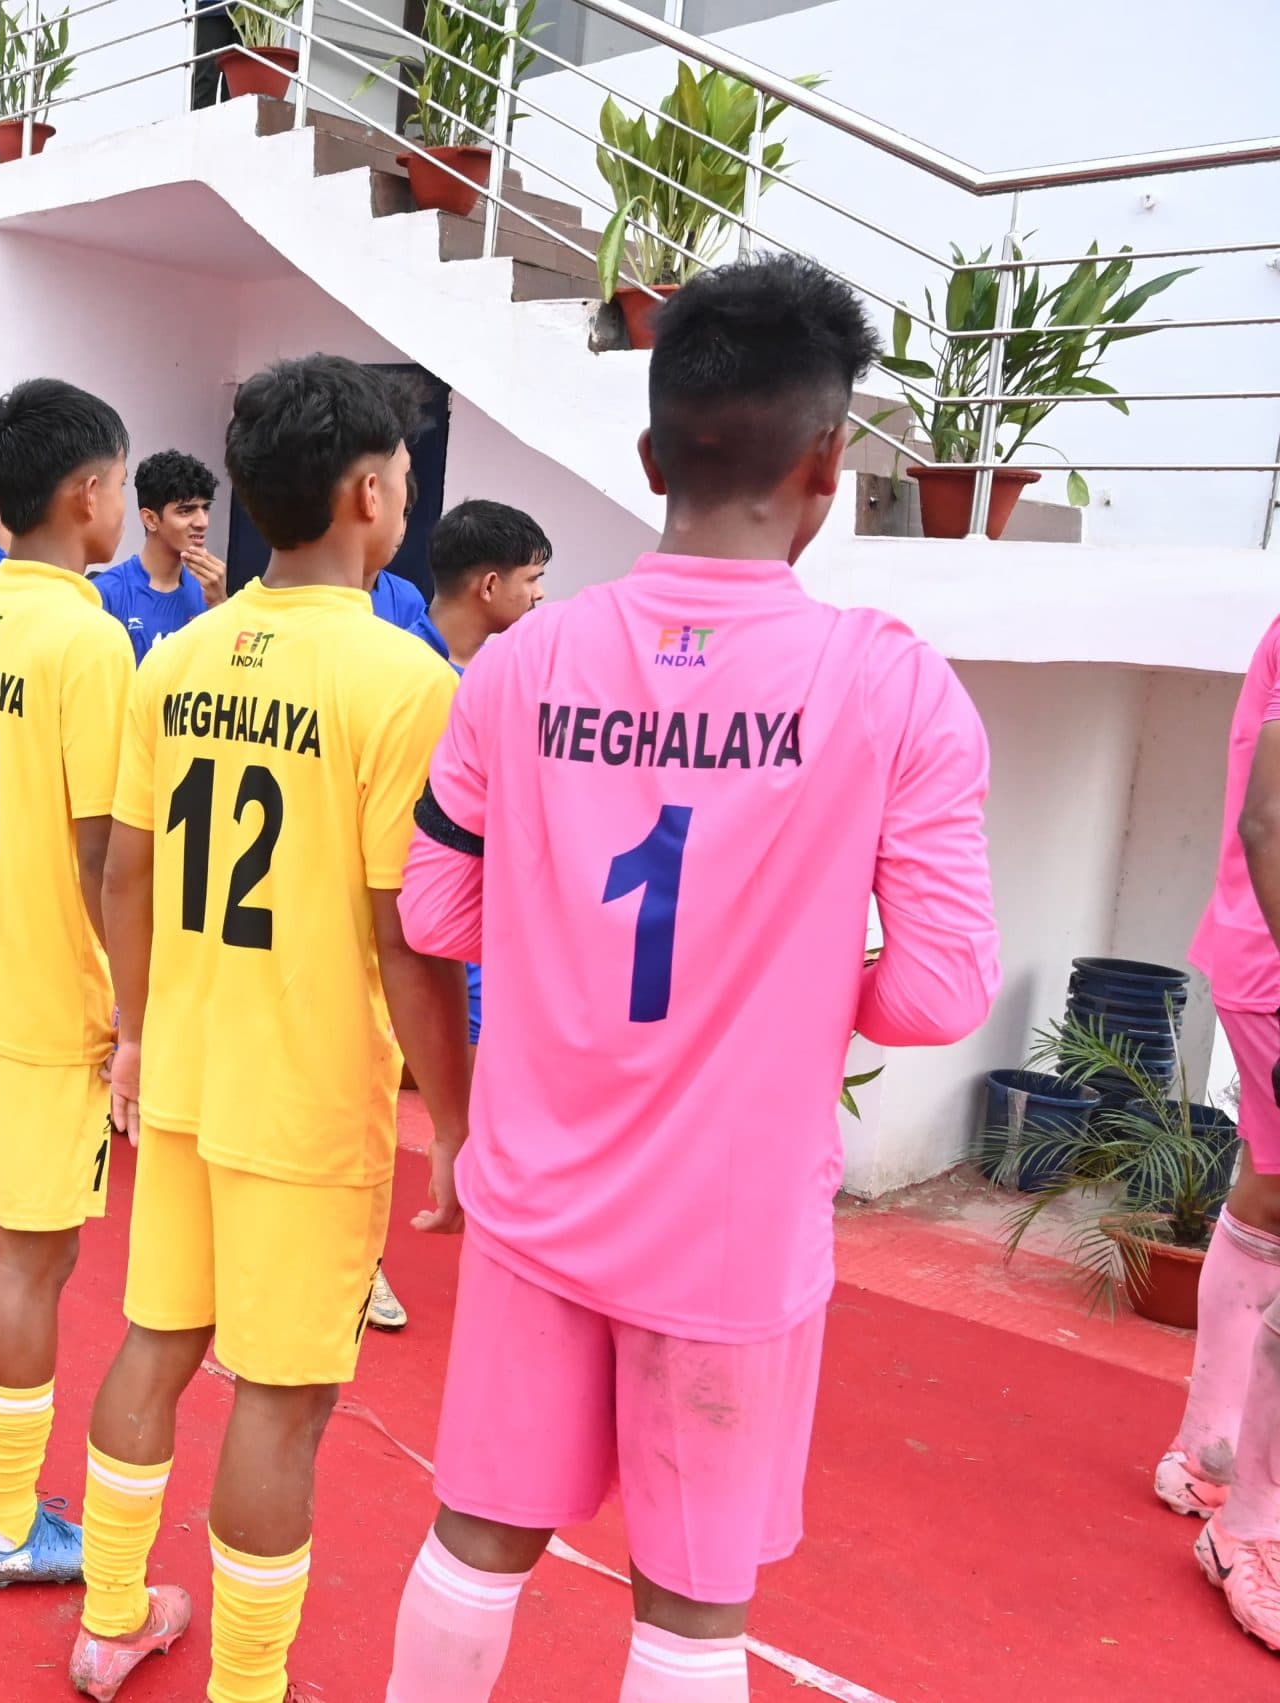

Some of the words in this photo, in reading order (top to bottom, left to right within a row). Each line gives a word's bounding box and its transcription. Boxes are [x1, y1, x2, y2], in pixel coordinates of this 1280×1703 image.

[231, 654, 264, 668] INDIA
[654, 653, 706, 667] INDIA
[163, 691, 320, 758] MEGHALAYA
[538, 702, 803, 769] MEGHALAYA
[166, 757, 283, 951] 12
[601, 804, 693, 1023] 1
